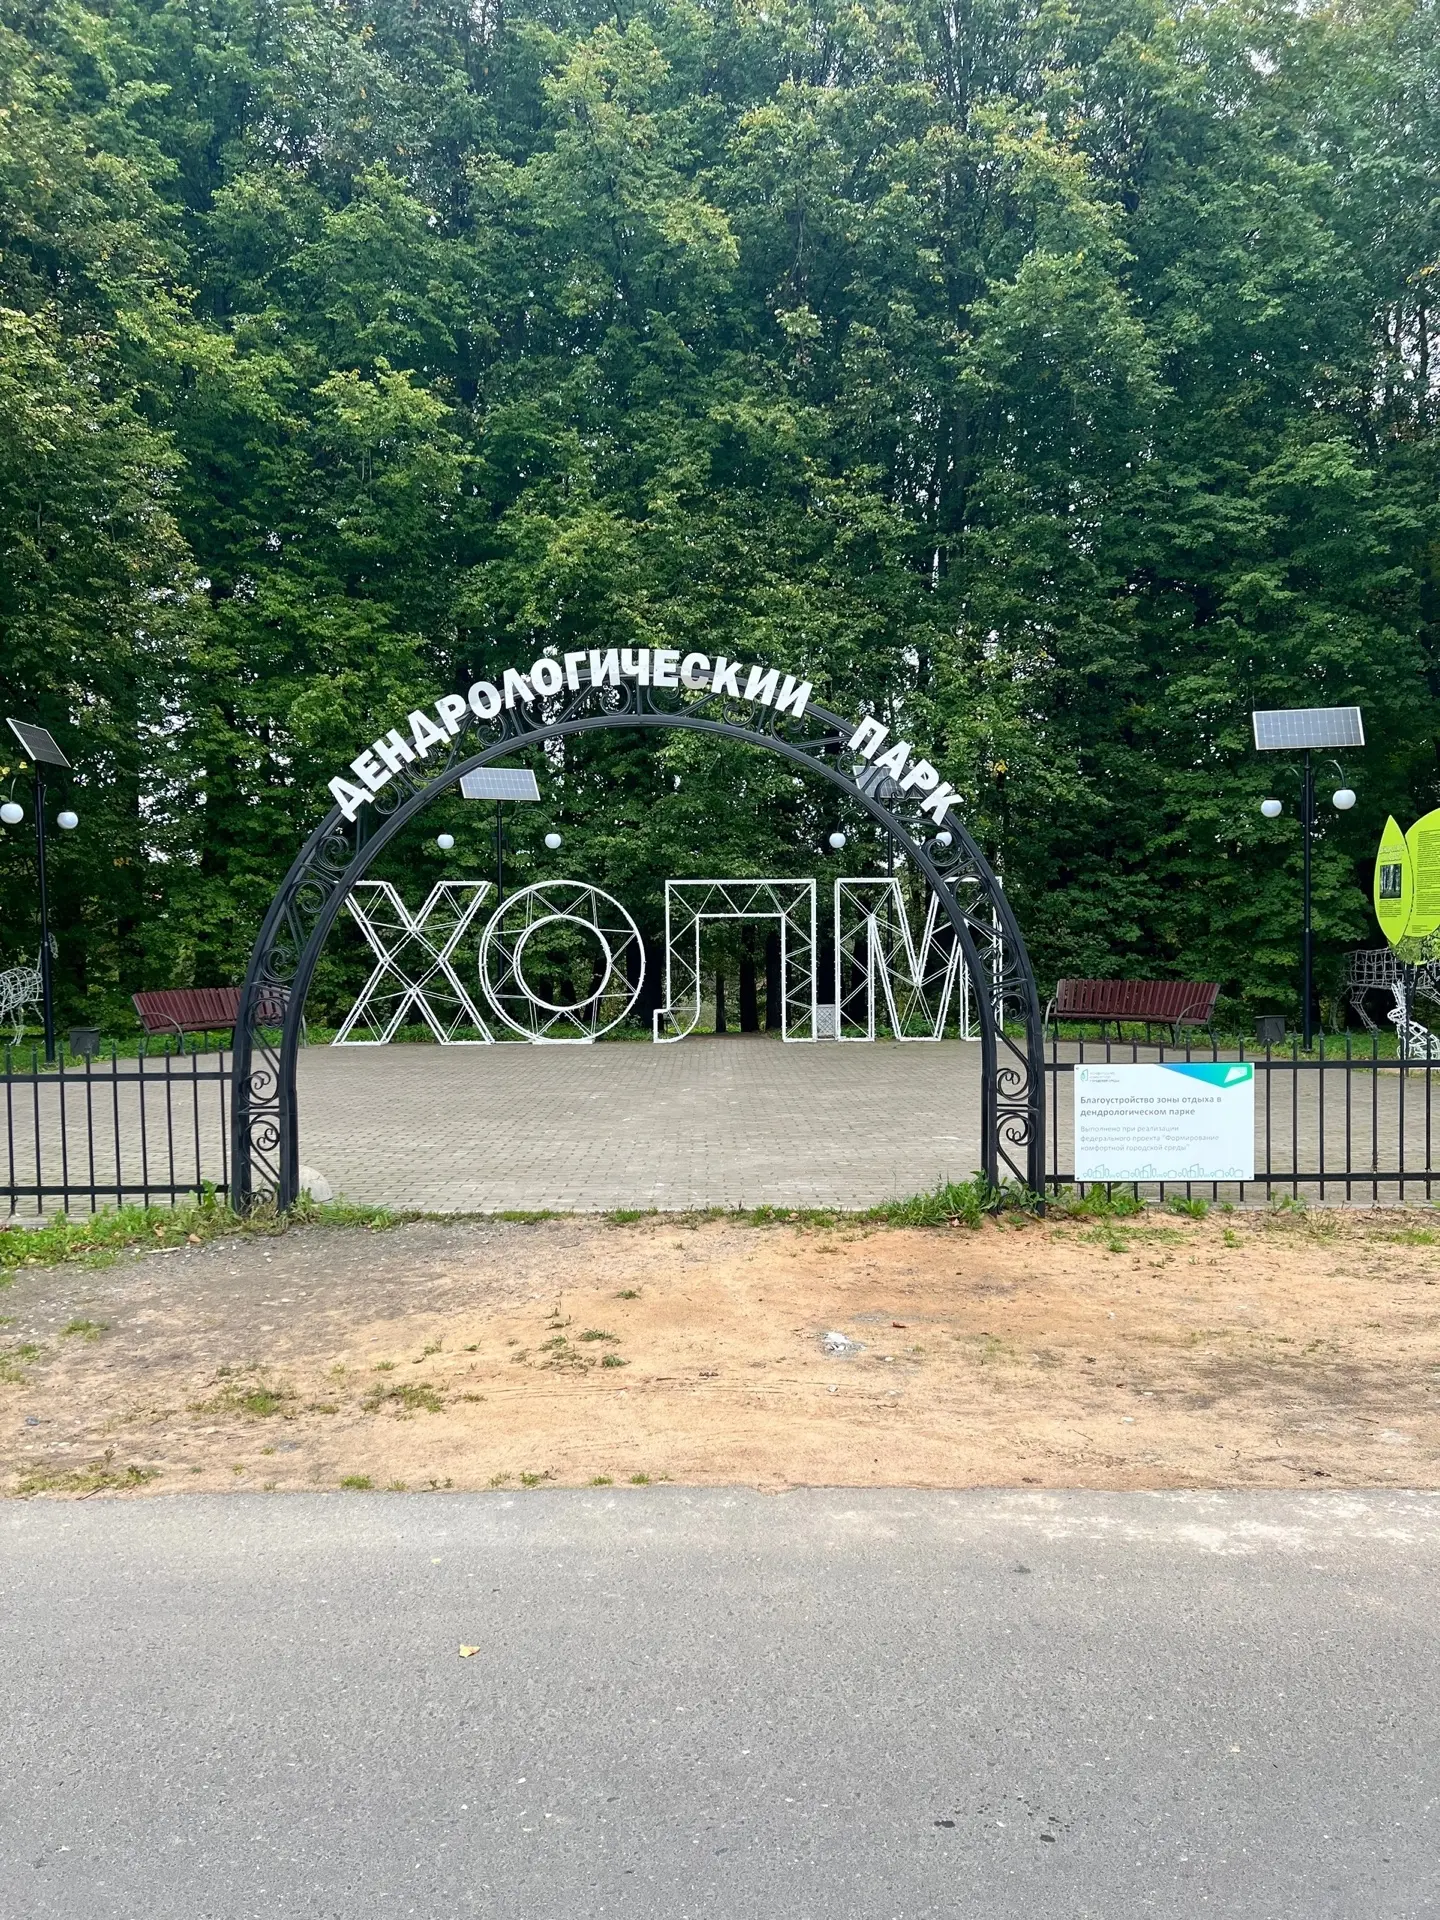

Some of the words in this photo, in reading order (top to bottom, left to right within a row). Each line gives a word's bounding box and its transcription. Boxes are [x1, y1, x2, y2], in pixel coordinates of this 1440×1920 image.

[847, 715, 965, 826] ПАРК
[330, 876, 1004, 1046] ХОЛМ
[1080, 1096, 1155, 1105] Благоустройство
[1181, 1096, 1215, 1105] отдыха
[1080, 1109, 1167, 1117] дендрологическом
[1169, 1109, 1196, 1117] парке
[1080, 1144, 1125, 1152] комфортной
[1126, 1144, 1163, 1152] городской
